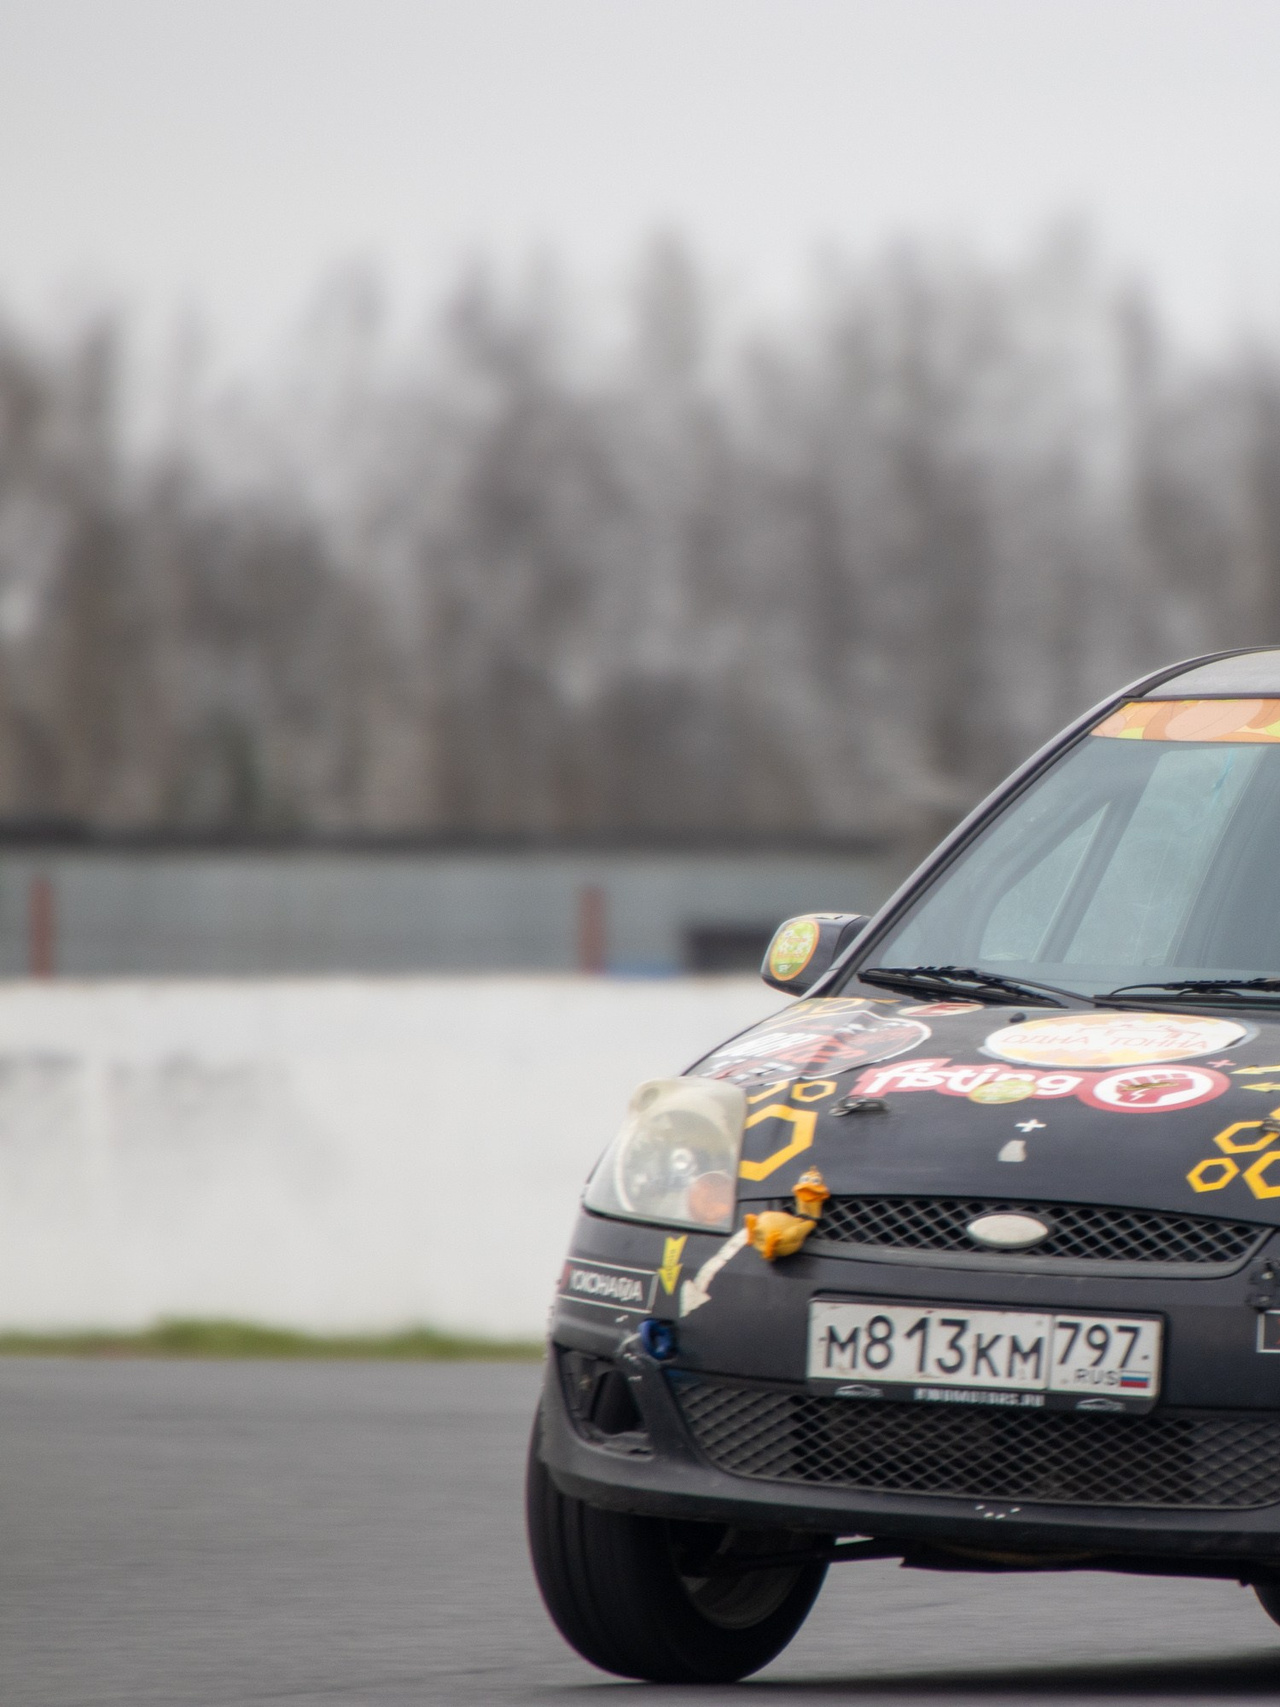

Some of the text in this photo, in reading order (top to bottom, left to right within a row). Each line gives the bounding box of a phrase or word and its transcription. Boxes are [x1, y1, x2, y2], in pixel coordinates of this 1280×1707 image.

[1002, 1033, 1208, 1050] ОДНА ТОННА
[1074, 1368, 1119, 1387] RUS
